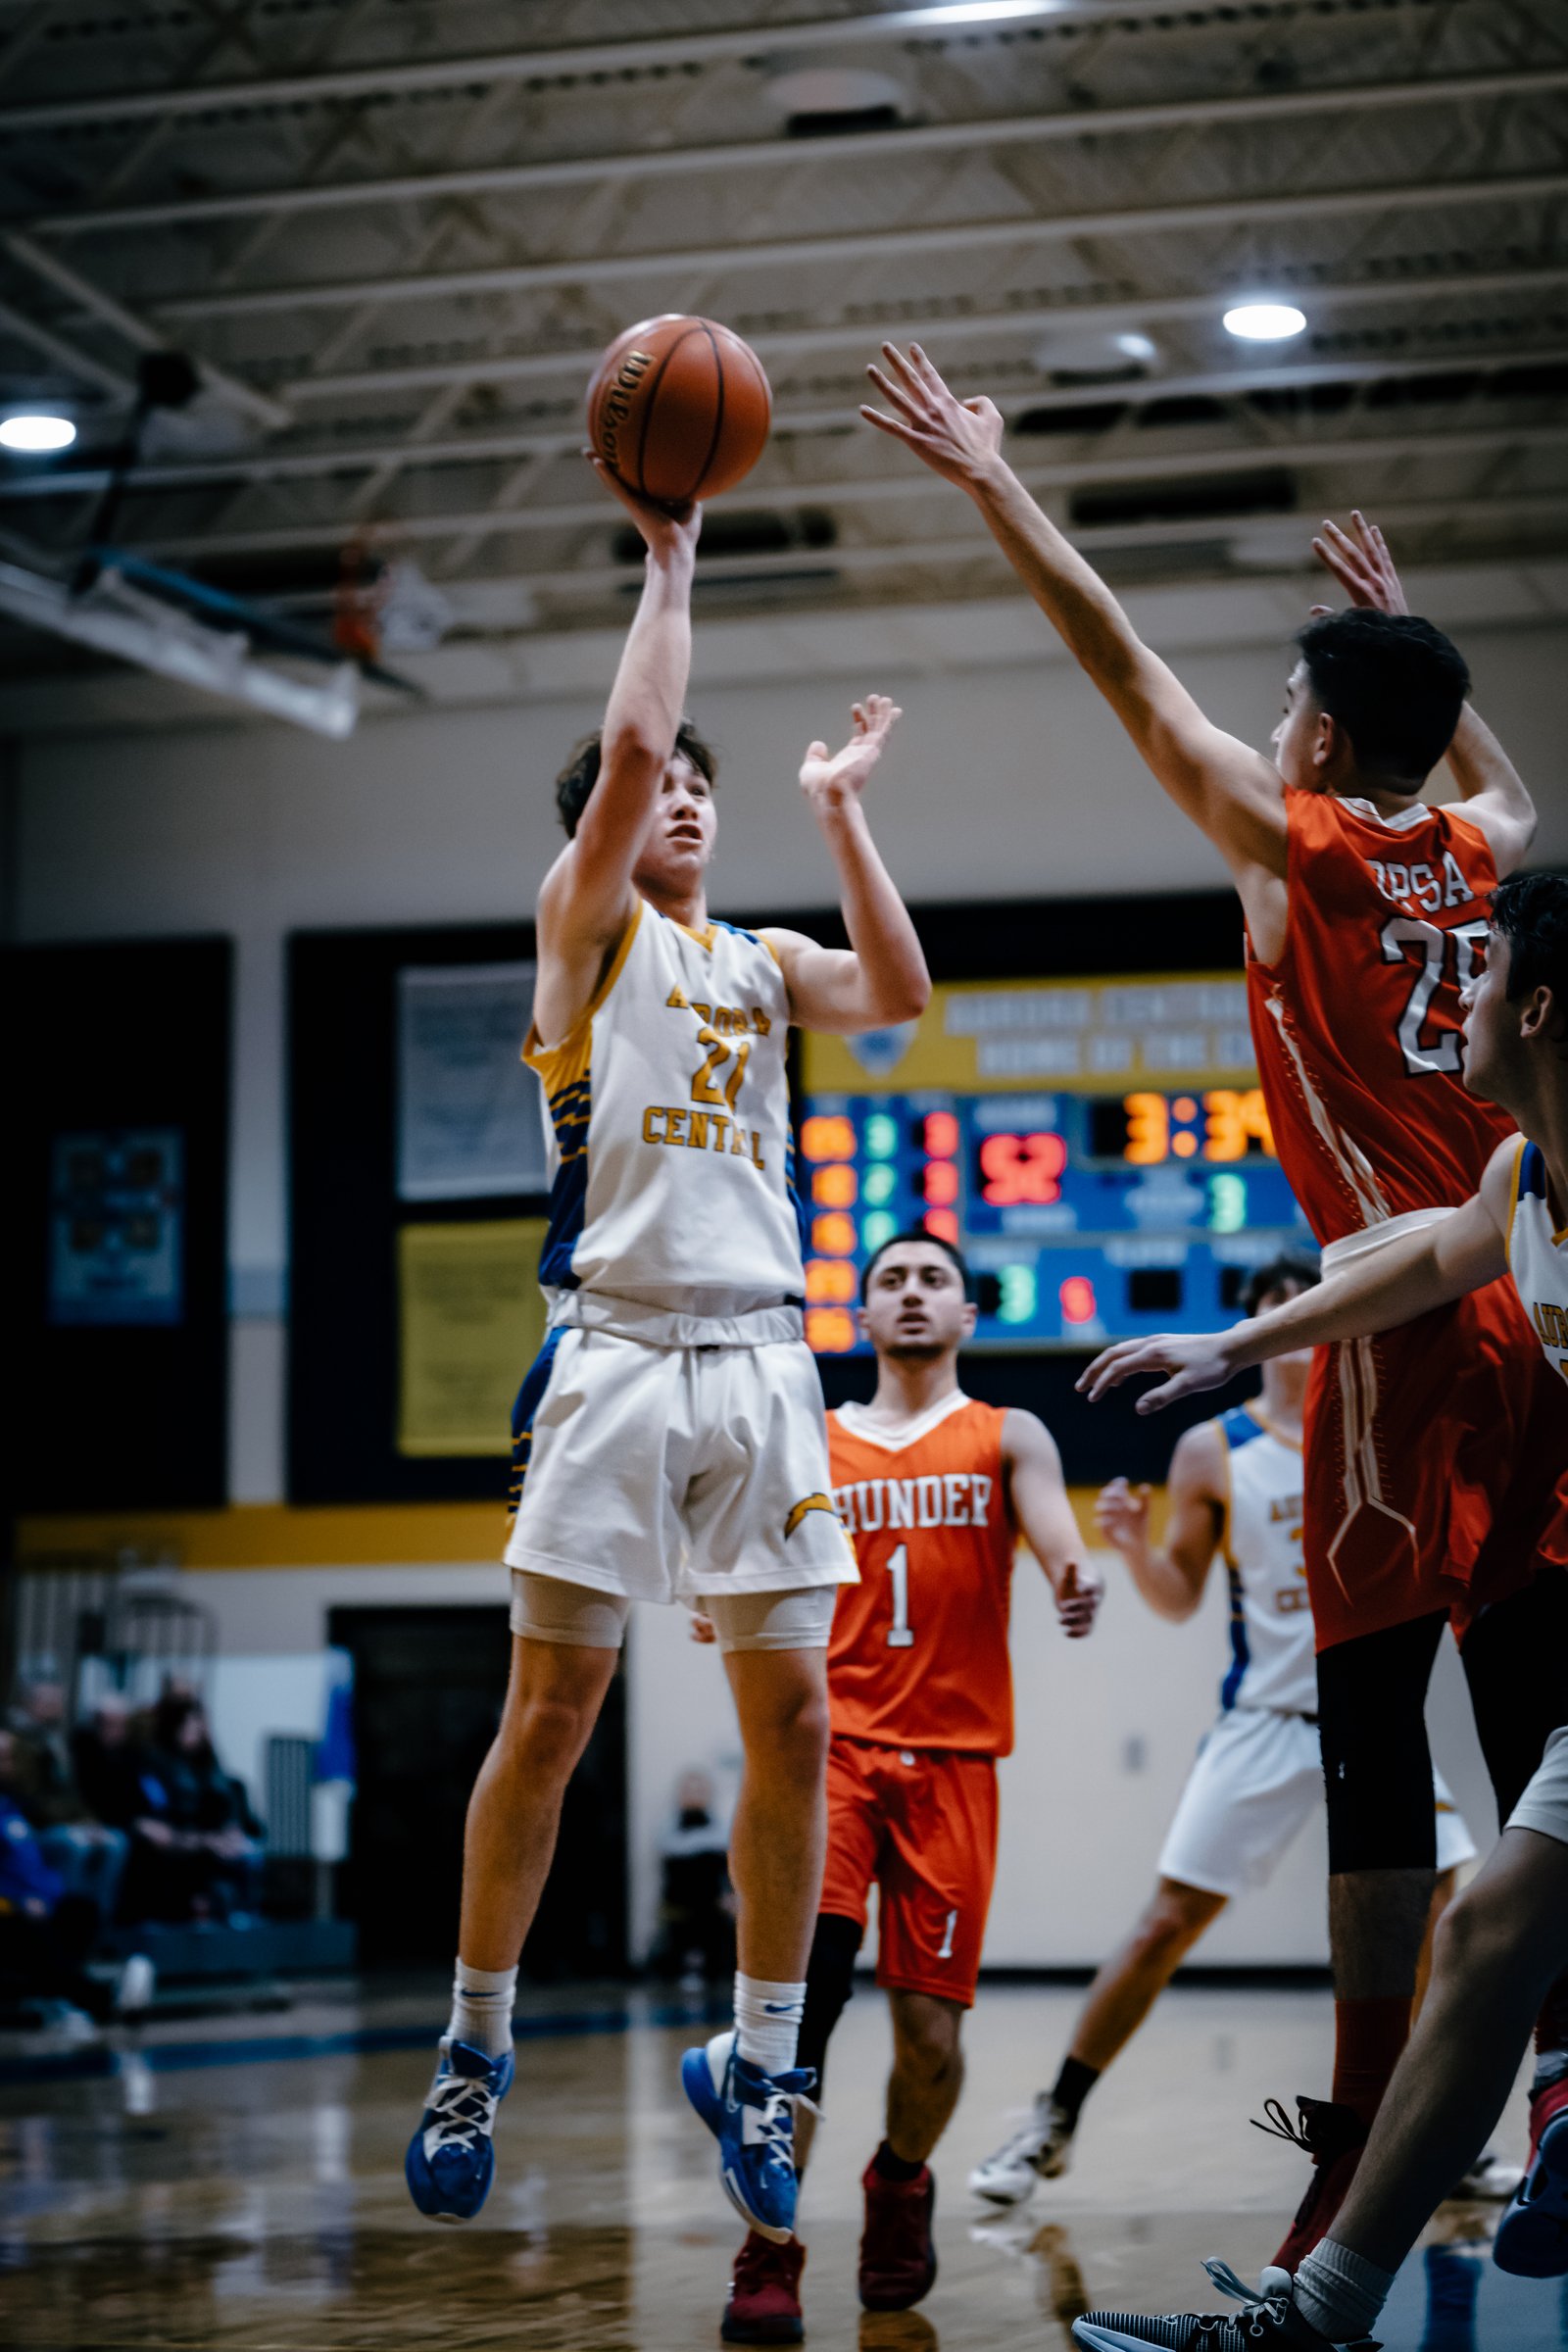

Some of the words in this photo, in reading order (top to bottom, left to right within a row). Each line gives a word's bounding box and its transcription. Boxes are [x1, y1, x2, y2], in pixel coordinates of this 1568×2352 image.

[832, 1473, 993, 1535] HUNDER
[886, 1543, 914, 1647] 1
[937, 1908, 958, 1958] 1
